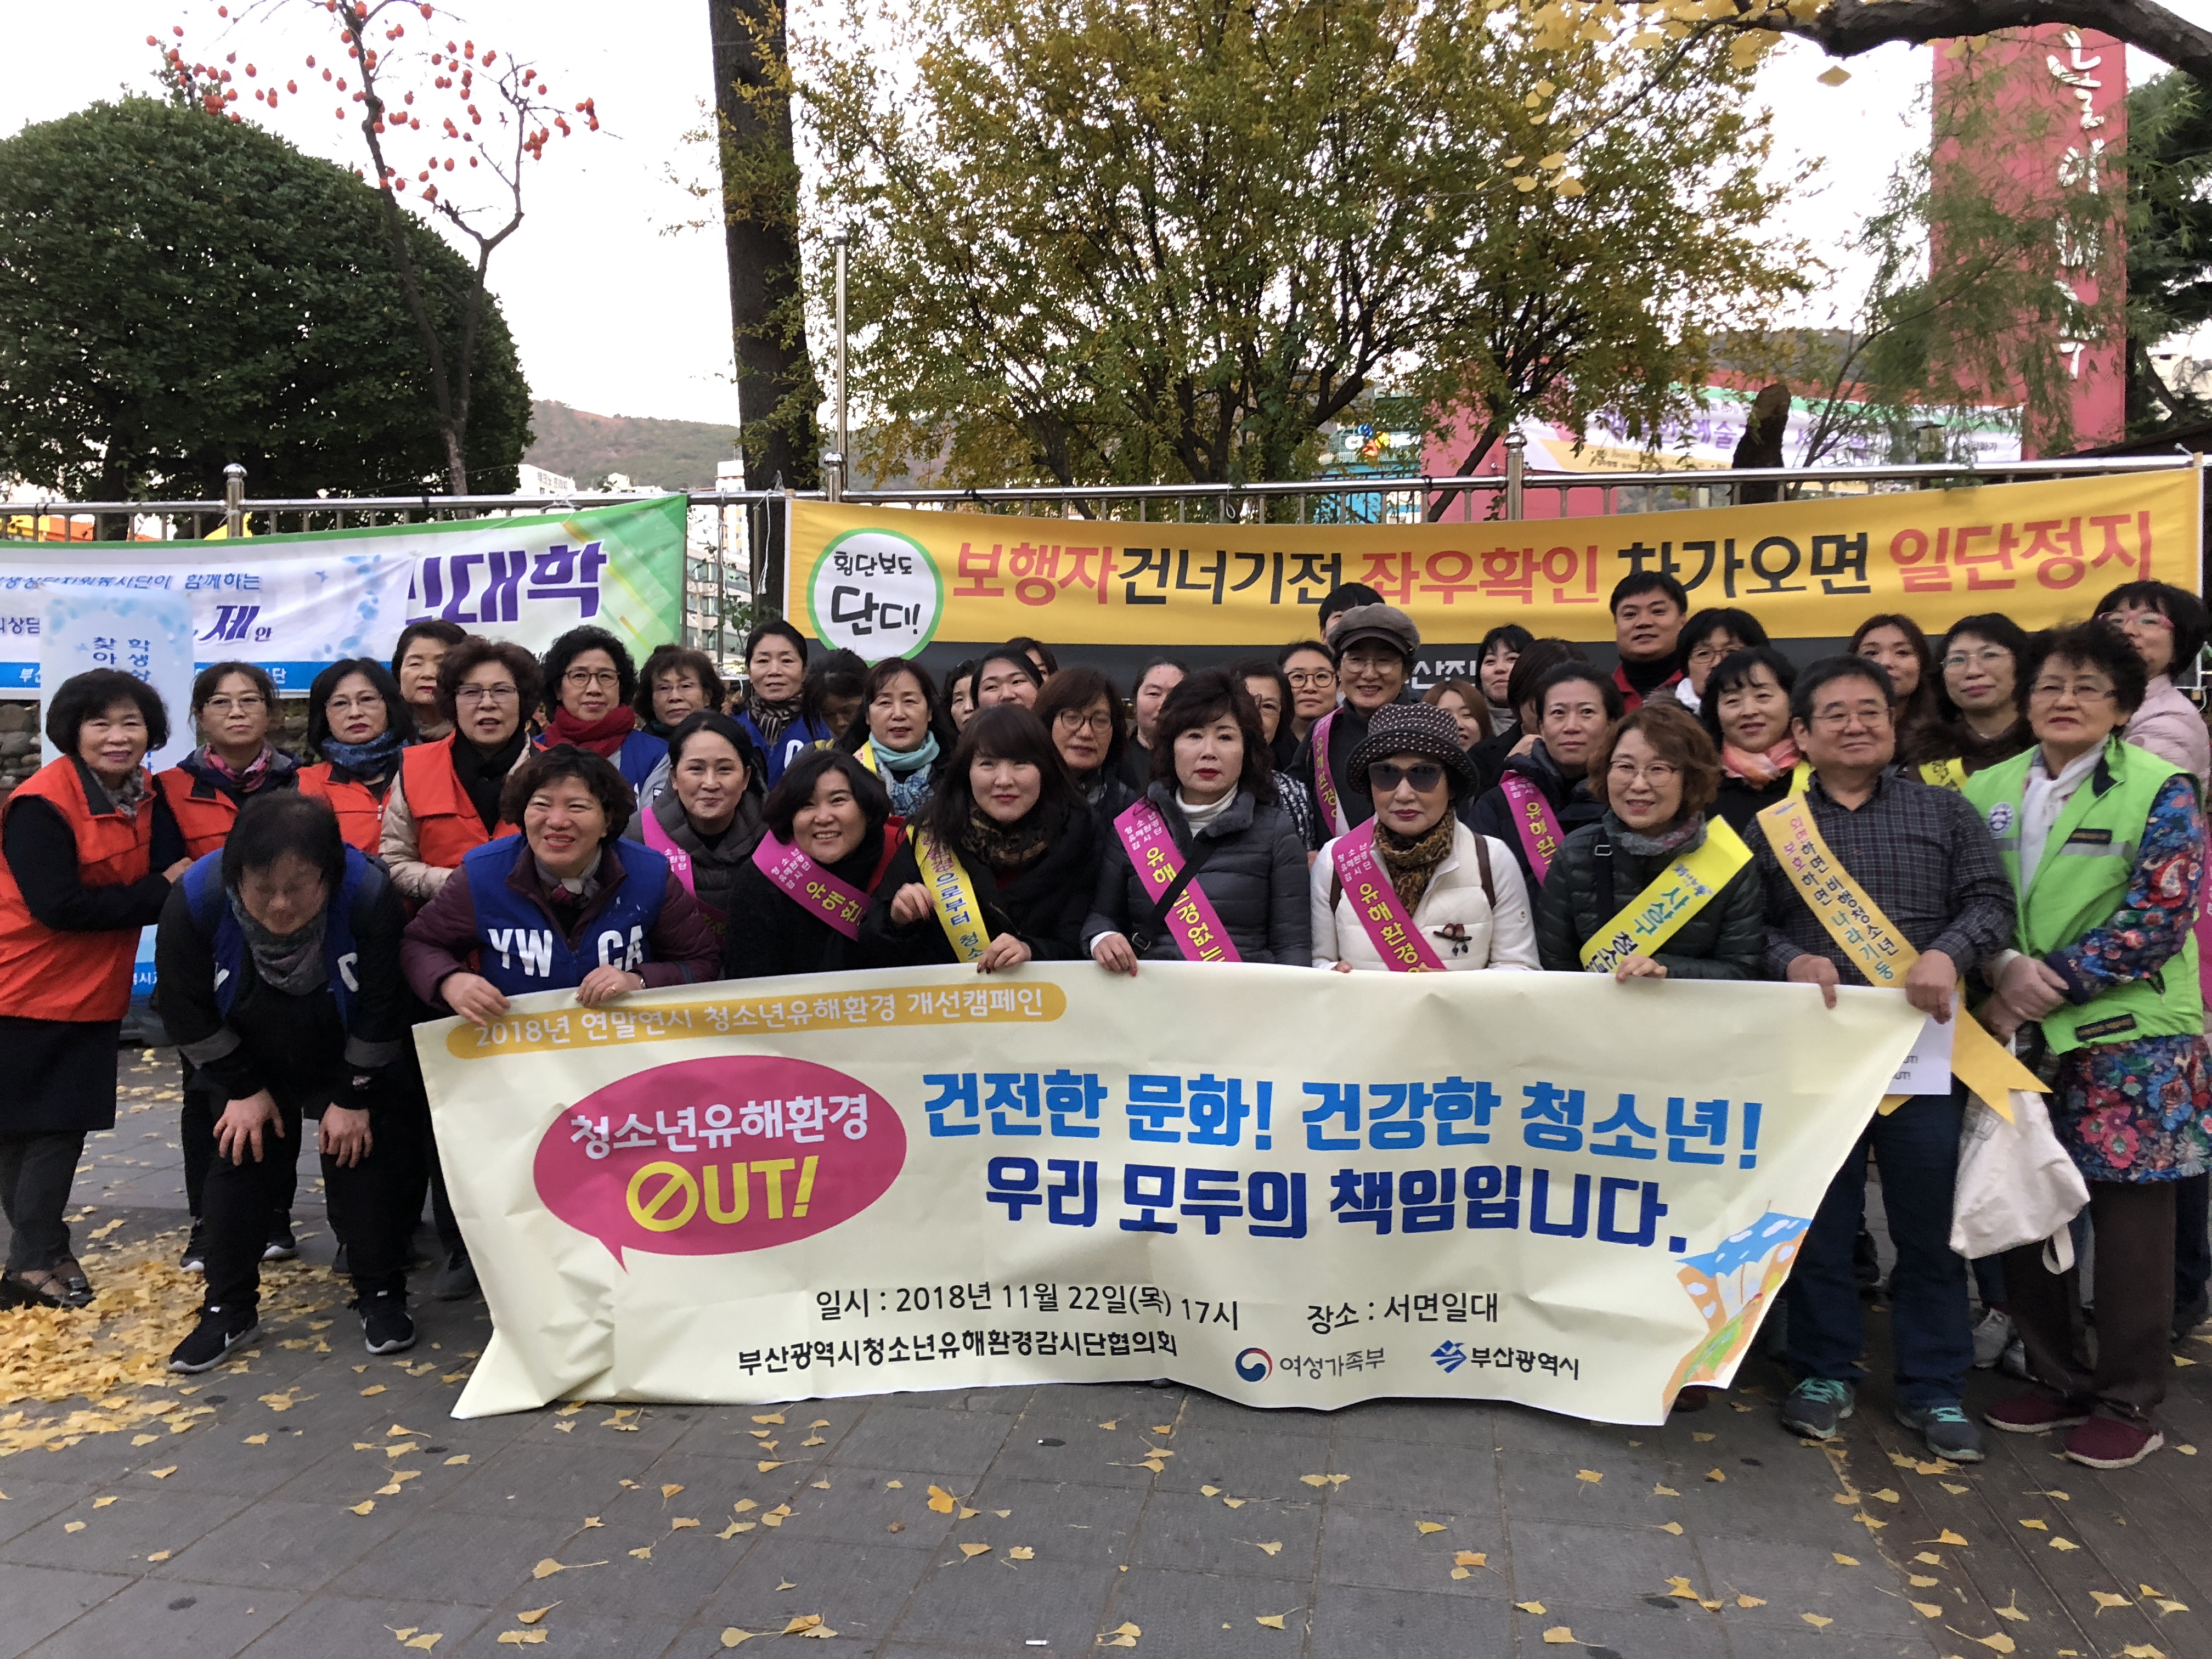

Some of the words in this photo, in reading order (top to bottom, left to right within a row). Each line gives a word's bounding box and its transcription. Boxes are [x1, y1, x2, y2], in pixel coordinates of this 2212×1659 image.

[185, 573, 261, 591] 함께하는
[834, 551, 912, 577] 횡단보도
[1360, 544, 1599, 604] 좌우확인
[1889, 510, 2151, 594] 일단정지
[831, 585, 921, 635] 단디!
[93, 636, 117, 665] 찾아
[1406, 659, 1477, 686] 산진
[1525, 802, 1558, 870] 유해환
[806, 881, 864, 927] 유해환
[1633, 886, 1691, 936] 사상구
[1783, 840, 1833, 907] 보호하면
[1830, 910, 1895, 980] 나라기둥
[1789, 816, 1830, 874] 외면하면
[1825, 874, 1900, 957] 비행청소년
[475, 1015, 571, 1047] 2018년
[581, 1008, 692, 1041] 연말연시
[704, 994, 895, 1031] 청소년유해환경
[907, 988, 1043, 1018] 개선캠페인
[1893, 1071, 1911, 1080] UT!
[1903, 1055, 1918, 1064] UT!
[569, 1093, 868, 1160] 청소년유해환경
[922, 1069, 1108, 1138] 건전한
[1125, 1073, 1273, 1150] 문화!
[1302, 1076, 1502, 1152] 건강한
[1521, 1081, 1763, 1170] 청소년!
[625, 1155, 819, 1232] OUT!
[986, 1156, 1098, 1228] 우리
[1119, 1164, 1308, 1239] 모두의
[1330, 1165, 1687, 1254] 책임입니다.
[816, 1288, 869, 1321] 일시
[896, 1282, 991, 1312] 2018년
[1002, 1283, 1059, 1312] 11월
[1068, 1285, 1172, 1317] 22일(목)
[1181, 1299, 1238, 1331] 17시
[1307, 1302, 1359, 1335] 장소
[1384, 1293, 1498, 1323] 서면일대
[738, 1329, 1178, 1376] 부산광역시청소년유해환경감시단협의회
[1279, 1347, 1385, 1380] 여성가족부
[1471, 1347, 1580, 1380] 부산광역시
